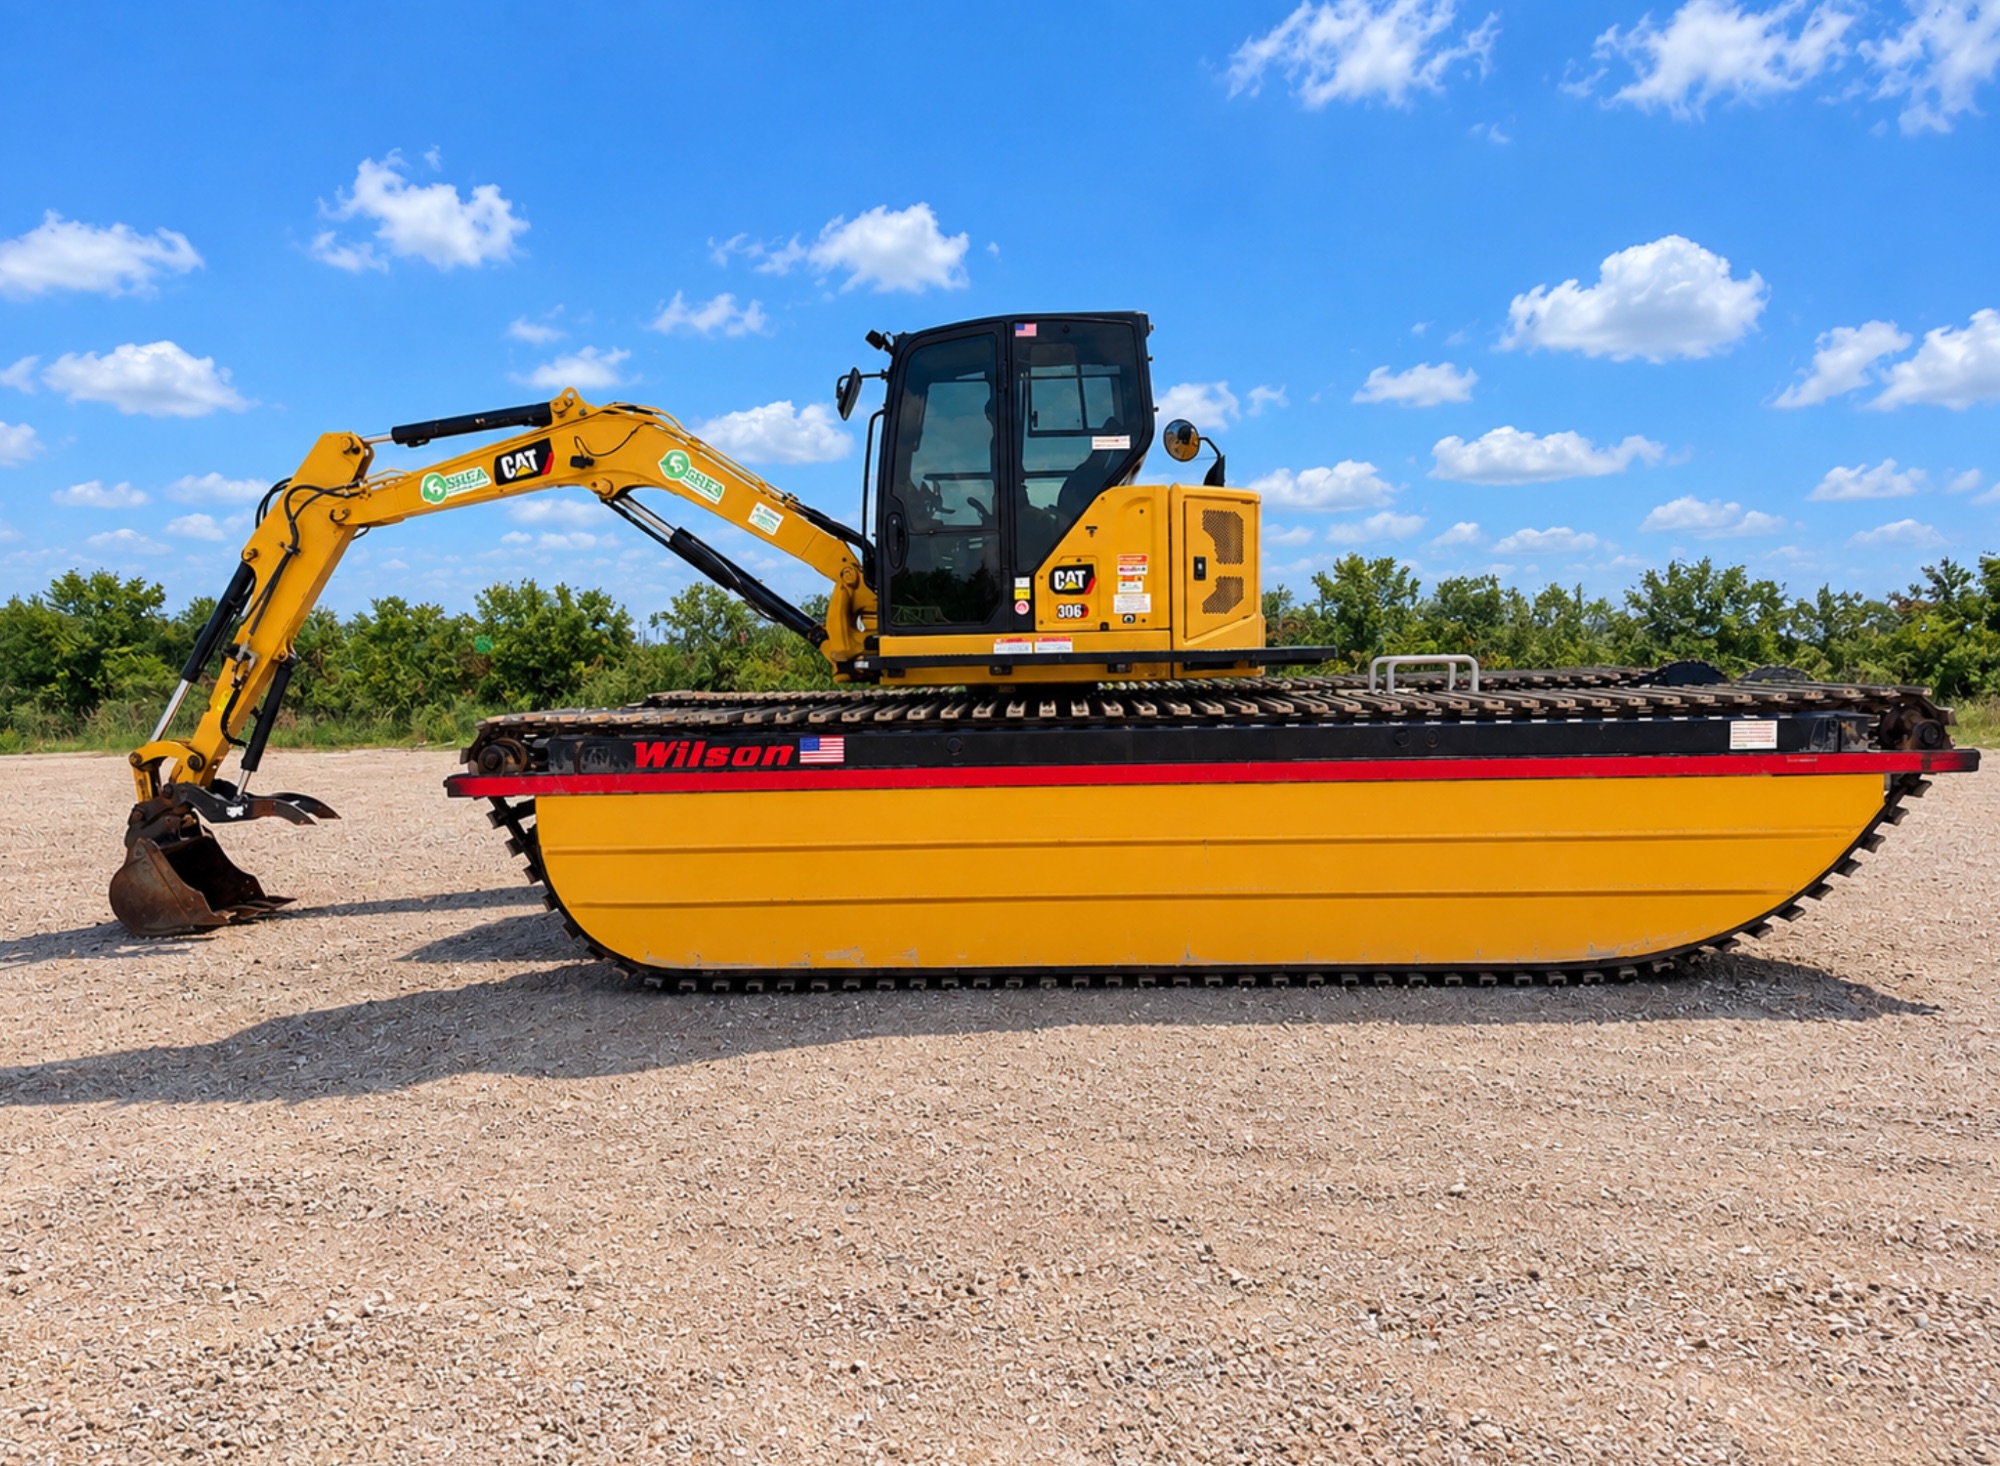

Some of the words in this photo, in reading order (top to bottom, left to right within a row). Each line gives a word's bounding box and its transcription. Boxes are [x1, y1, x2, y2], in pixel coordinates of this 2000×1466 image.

[501, 448, 539, 479] CAT
[1054, 570, 1086, 590] CAT
[1057, 604, 1082, 618] 306
[633, 740, 794, 768] Wilson
